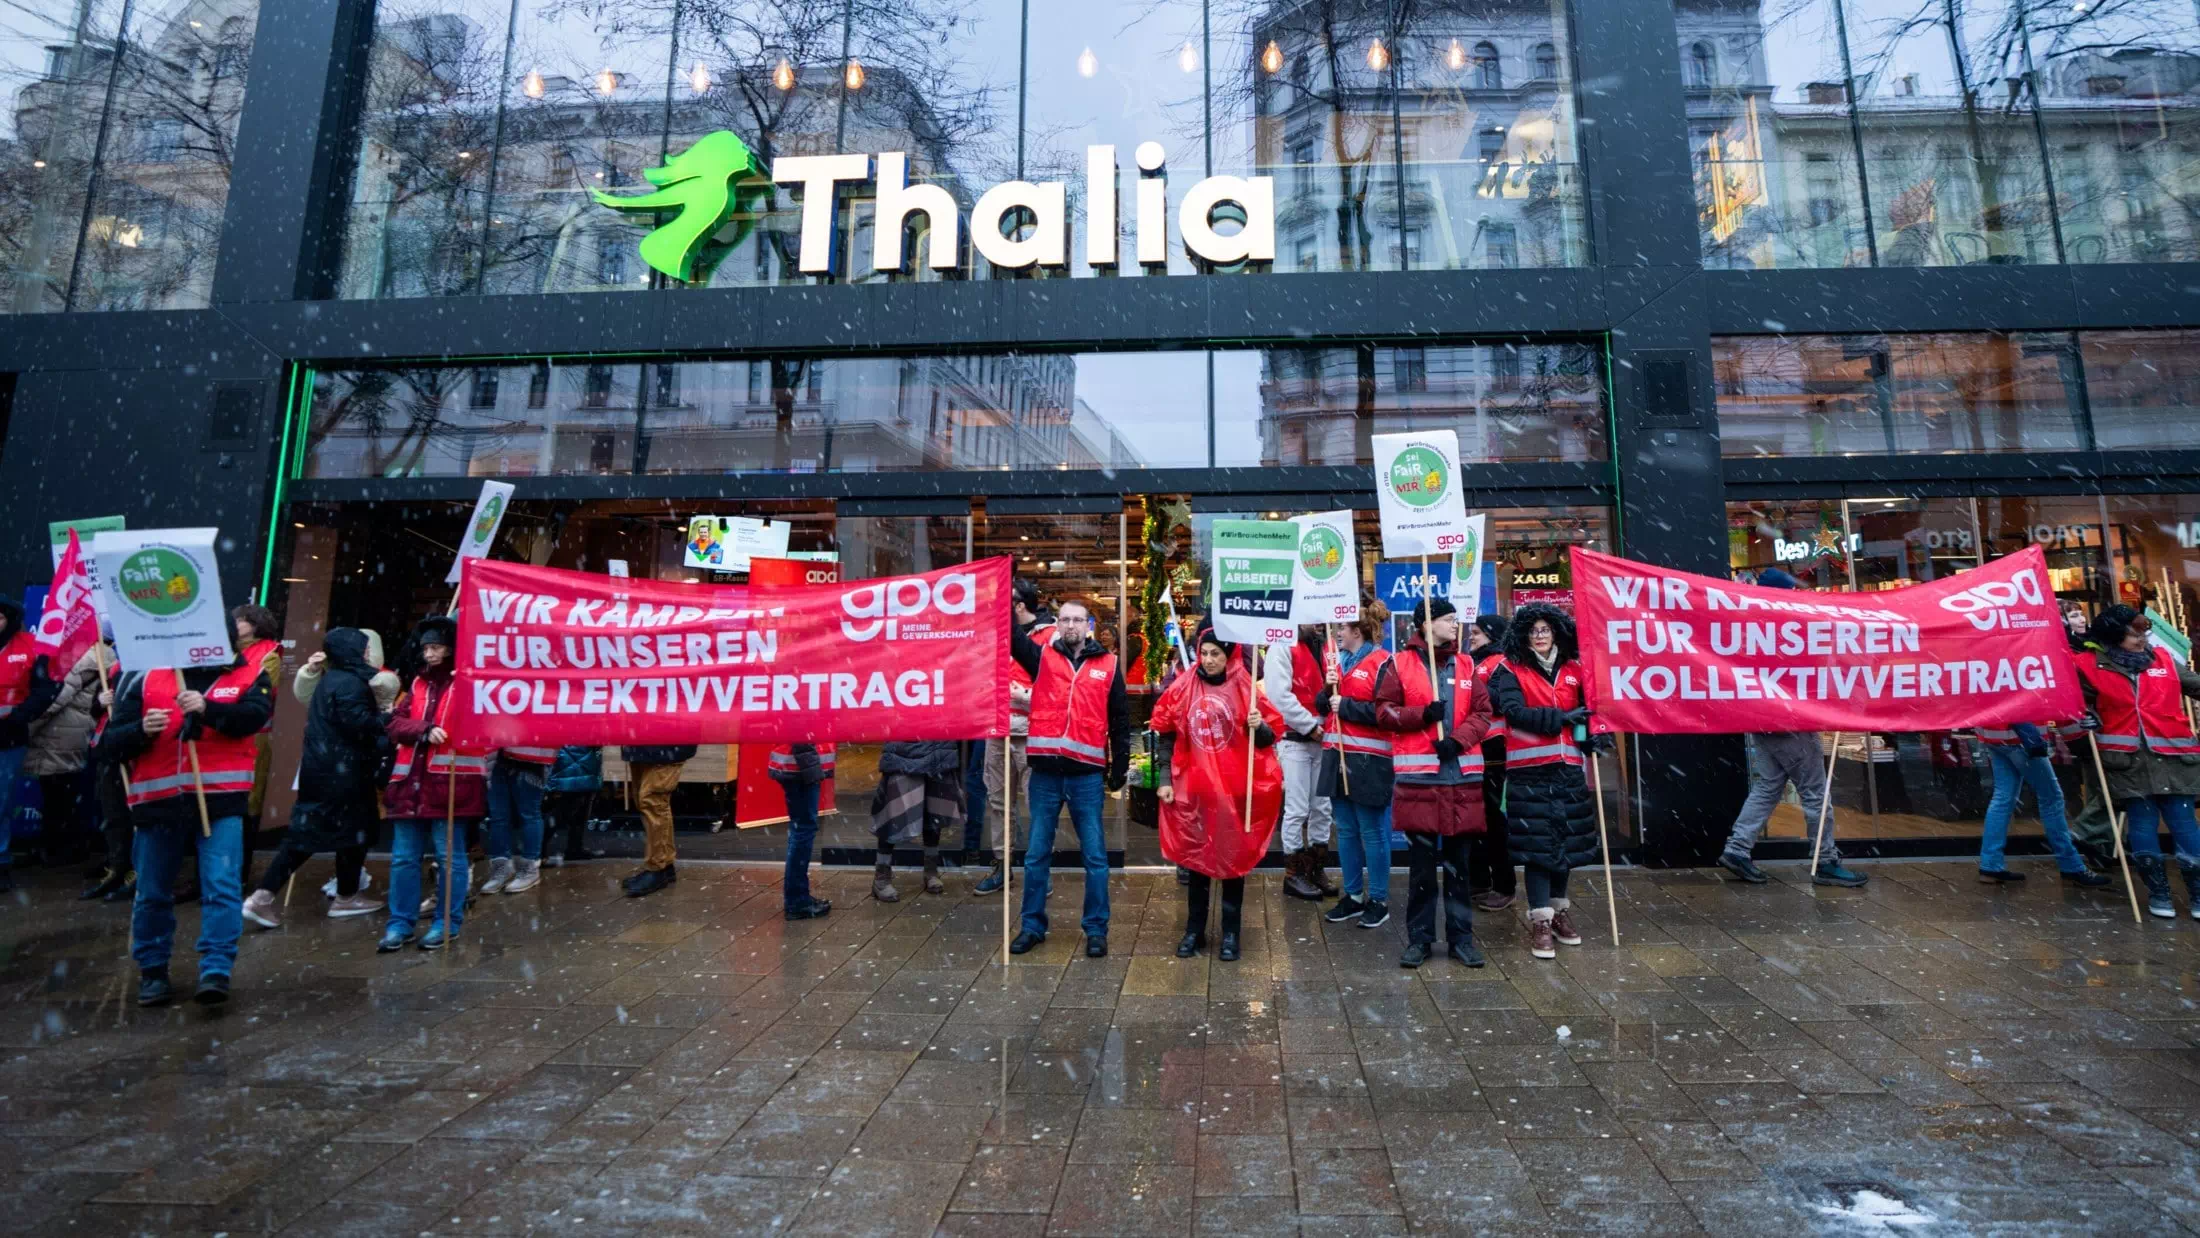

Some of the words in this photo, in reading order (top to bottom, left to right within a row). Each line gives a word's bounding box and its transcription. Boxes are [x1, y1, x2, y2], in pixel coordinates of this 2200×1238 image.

[772, 141, 1275, 273] Thalia
[1405, 452, 1419, 462] sei
[1393, 463, 1423, 477] FaiR
[1396, 481, 1420, 494] MIR
[1397, 520, 1452, 530] #WirBrauchenMehr
[1221, 531, 1291, 540] #WirBrauchenMehr
[1437, 534, 1464, 549] gpa
[138, 553, 158, 566] sei
[1224, 559, 1250, 570] WIR
[1303, 558, 1322, 569] MIR
[123, 566, 165, 582] FaiR
[1225, 572, 1288, 585] ARBEITEN
[129, 588, 160, 600] MIR
[1600, 576, 1693, 610] WIR
[1939, 568, 2044, 632] gpa
[478, 589, 560, 624] WIR
[840, 573, 976, 642] gpa
[1224, 597, 1250, 610] FÜR
[1253, 600, 1288, 612] ZWEI
[1334, 605, 1356, 619] gpa
[902, 624, 932, 632] MEINE
[1265, 628, 1293, 643] gpa
[1607, 613, 1699, 654] FÜR
[1710, 621, 1920, 656] UNSEREN
[902, 631, 975, 641] GEWERKSCHAFT
[189, 646, 225, 664] gpa
[475, 627, 557, 669] FÜR
[564, 630, 778, 669] UNSEREN
[1610, 655, 2056, 701] KOLLEKTIVVERTRAG!
[473, 669, 945, 714] KOLLEKTIVVERTRAG!
